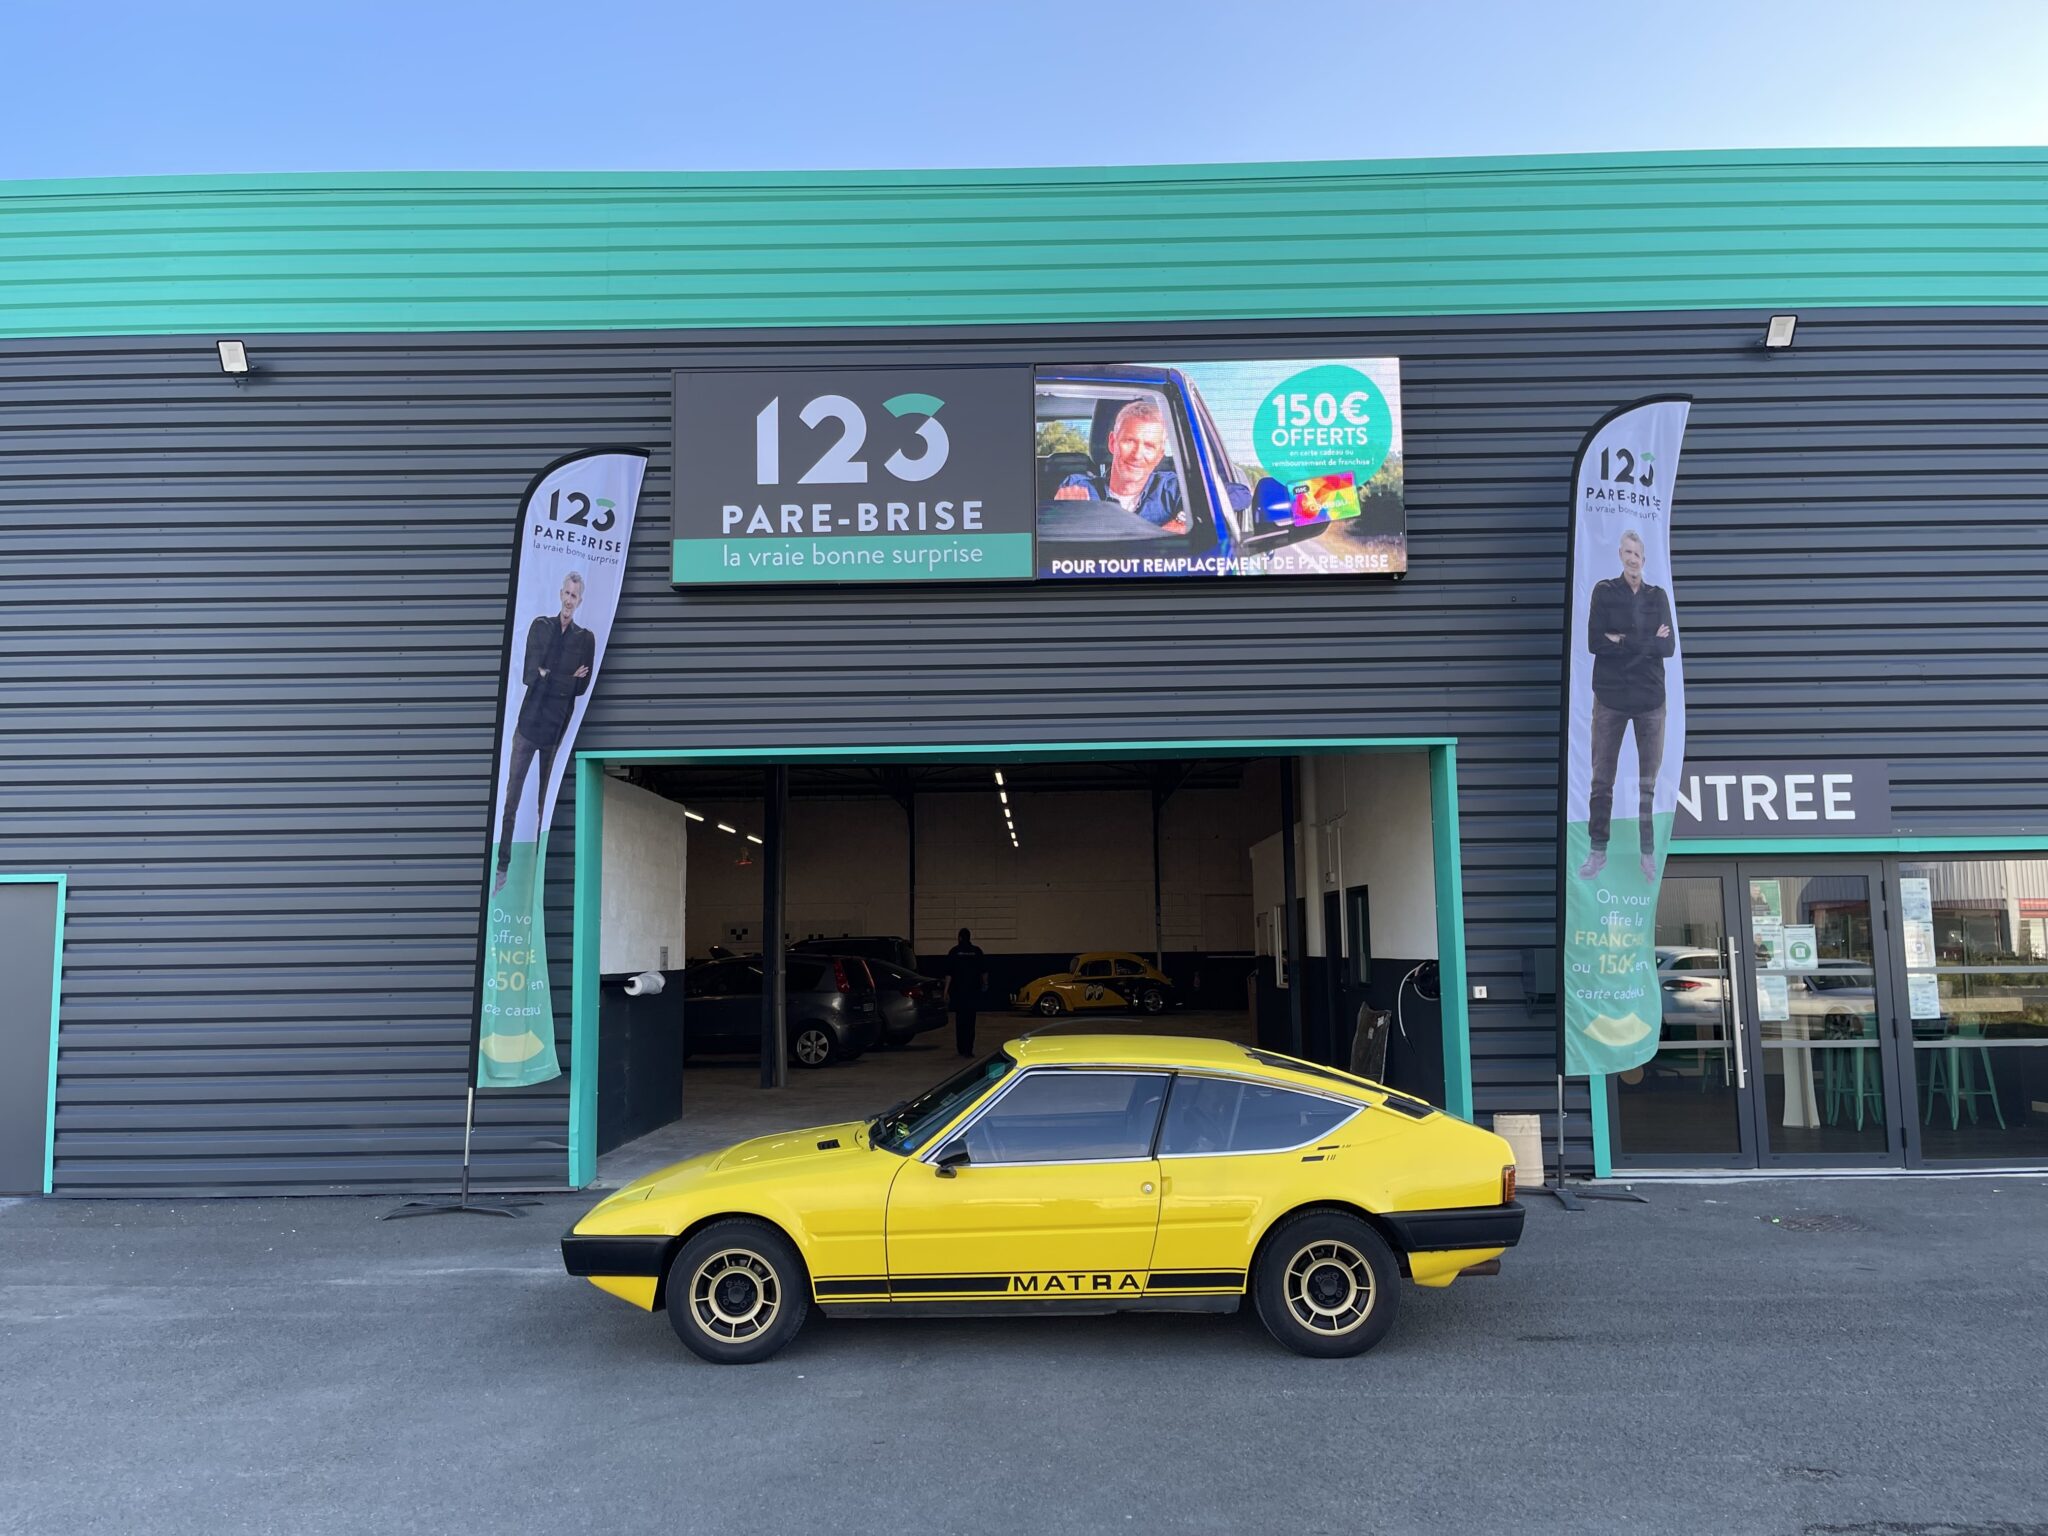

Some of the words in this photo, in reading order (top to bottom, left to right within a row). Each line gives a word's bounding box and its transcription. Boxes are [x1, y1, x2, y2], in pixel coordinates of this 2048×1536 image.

[1271, 391, 1370, 427] 150€
[756, 393, 950, 485] 123
[1271, 427, 1368, 447] OFFERTS
[549, 488, 616, 532] 123
[722, 501, 983, 534] PARE-BRISE
[533, 539, 541, 549] la
[543, 542, 564, 553] vraie
[534, 525, 622, 553] PARE-BRISE
[723, 544, 741, 567] la
[748, 544, 804, 566] vraie
[812, 543, 885, 566] bonne
[892, 541, 983, 572] surprise
[1052, 559, 1096, 574] POUR
[1099, 558, 1140, 573] TOUT
[1143, 556, 1270, 573] REMPLACEMENT
[1273, 556, 1295, 570] DE
[1299, 554, 1389, 570] PARE-BRISE
[1677, 774, 1856, 822] NTREE
[1596, 888, 1619, 904] On
[493, 908, 511, 924] On
[1600, 910, 1632, 927] offre
[1572, 963, 1591, 973] ou
[1576, 988, 1612, 1000] carte
[1013, 1274, 1141, 1292] MATRA
